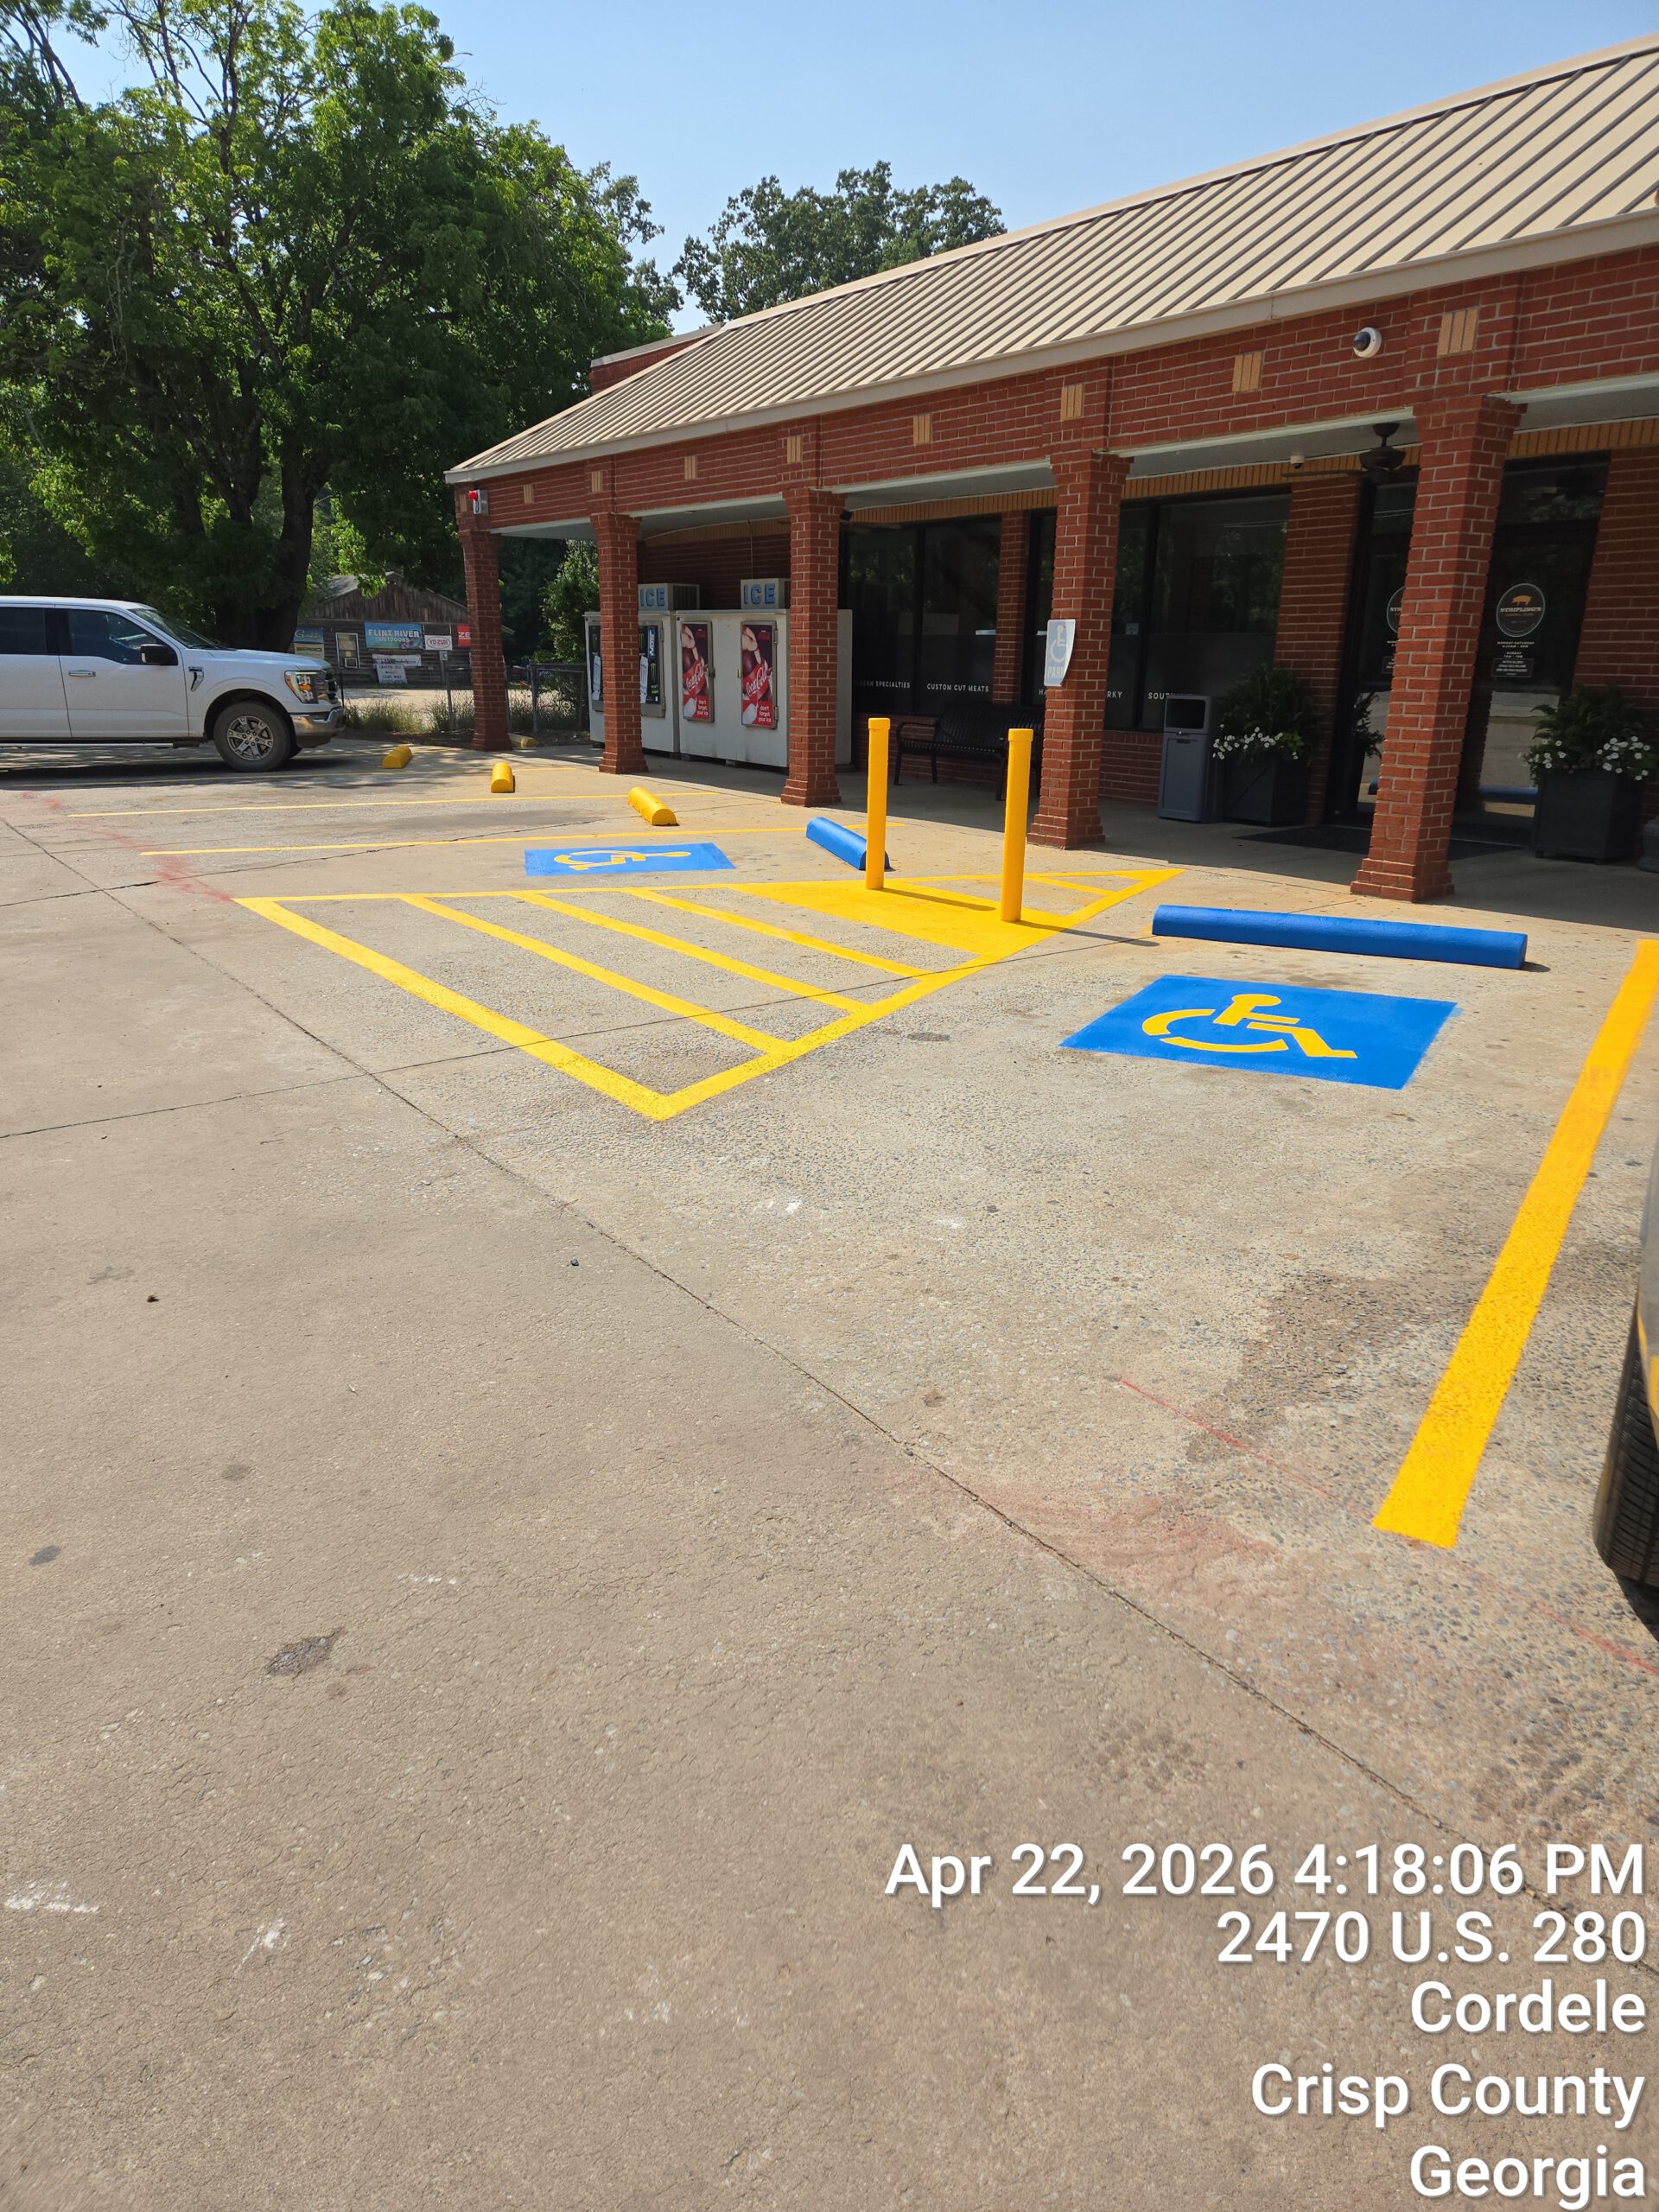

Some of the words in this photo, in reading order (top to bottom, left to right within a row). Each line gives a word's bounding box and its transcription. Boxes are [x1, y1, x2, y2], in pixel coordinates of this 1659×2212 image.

[640, 587, 665, 607] ICE
[743, 583, 775, 605] ICE
[875, 680, 911, 689] SPECIALTIES
